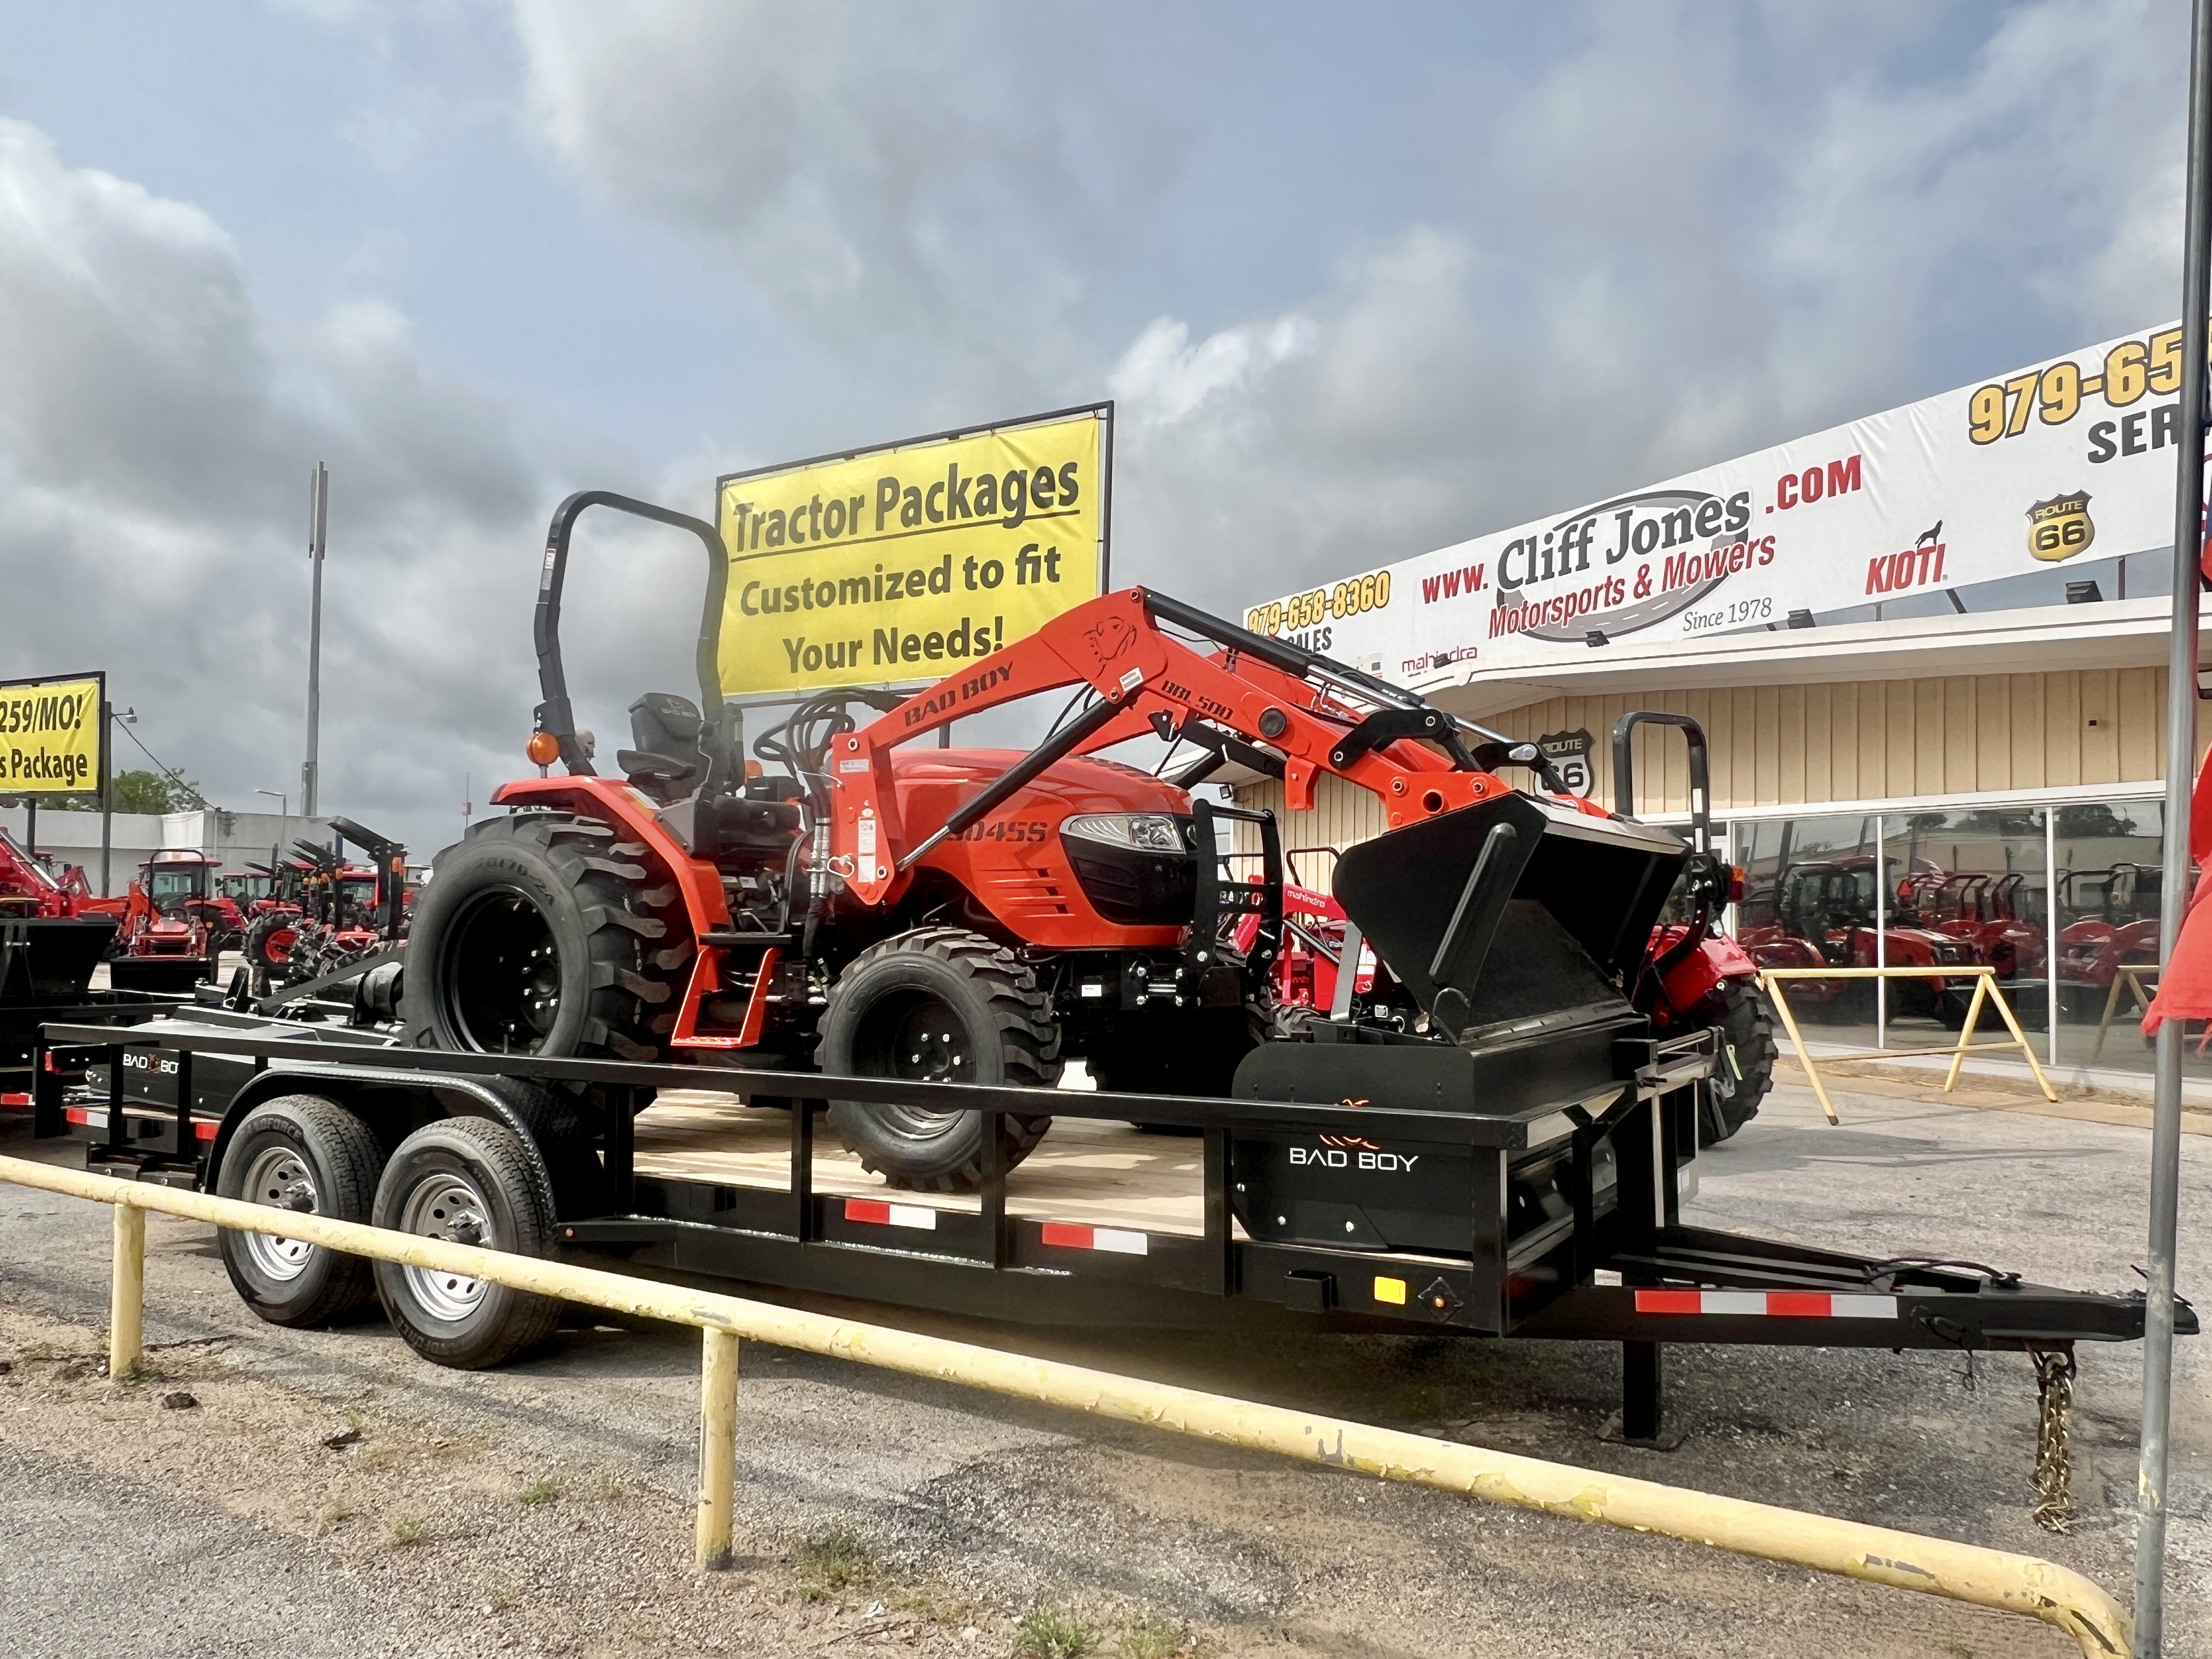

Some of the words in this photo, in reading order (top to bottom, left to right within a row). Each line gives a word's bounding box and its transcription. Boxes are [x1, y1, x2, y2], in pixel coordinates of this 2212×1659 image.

[1968, 327, 2182, 445] 979-65
[2087, 404, 2181, 464] SER
[733, 494, 865, 552] Tractor
[876, 461, 1080, 531] Packages
[1422, 563, 1488, 603] www.
[1497, 518, 1597, 590] Cliff
[1606, 492, 1750, 565] Jones
[1765, 454, 1861, 514] .COM
[2035, 500, 2083, 520] ROUTE
[2036, 520, 2085, 551] 66
[741, 554, 952, 616] Customized
[963, 555, 1005, 593] to
[1015, 544, 1061, 585] fit
[1488, 575, 1625, 640] Motorsports
[1633, 564, 1652, 600] &
[1661, 535, 1775, 592] Mowers
[1865, 543, 1946, 595] KIOTI
[1248, 571, 1391, 636] 979-658-8360
[1683, 611, 1724, 631] Since
[1728, 597, 1771, 623] 1978
[782, 636, 863, 673] Your
[873, 616, 1003, 665] Needs!
[1402, 646, 1477, 673] mahdra
[905, 690, 956, 727] BAD
[962, 661, 1013, 700] BOY
[12, 746, 87, 787] Package
[1541, 763, 1584, 791] 6
[945, 821, 1048, 842] 045S
[123, 1053, 148, 1069] BAD
[160, 1059, 179, 1074] BO
[1290, 1147, 1347, 1167] BAD
[1358, 1152, 1419, 1172] BOY
